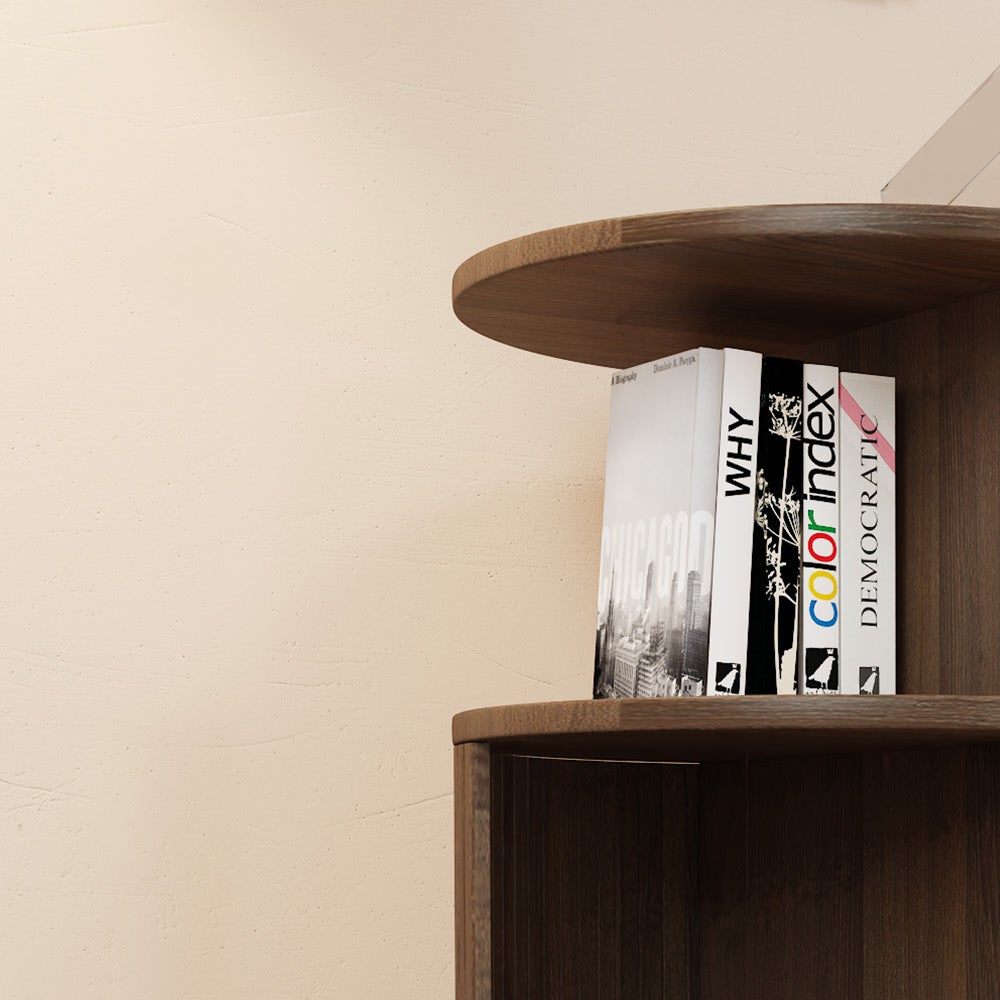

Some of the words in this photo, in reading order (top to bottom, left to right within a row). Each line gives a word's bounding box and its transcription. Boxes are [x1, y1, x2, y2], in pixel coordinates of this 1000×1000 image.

[724, 406, 754, 497] WHY
[802, 382, 837, 505] index
[803, 509, 838, 628] color
[859, 414, 879, 628] DEMOCRATIC
